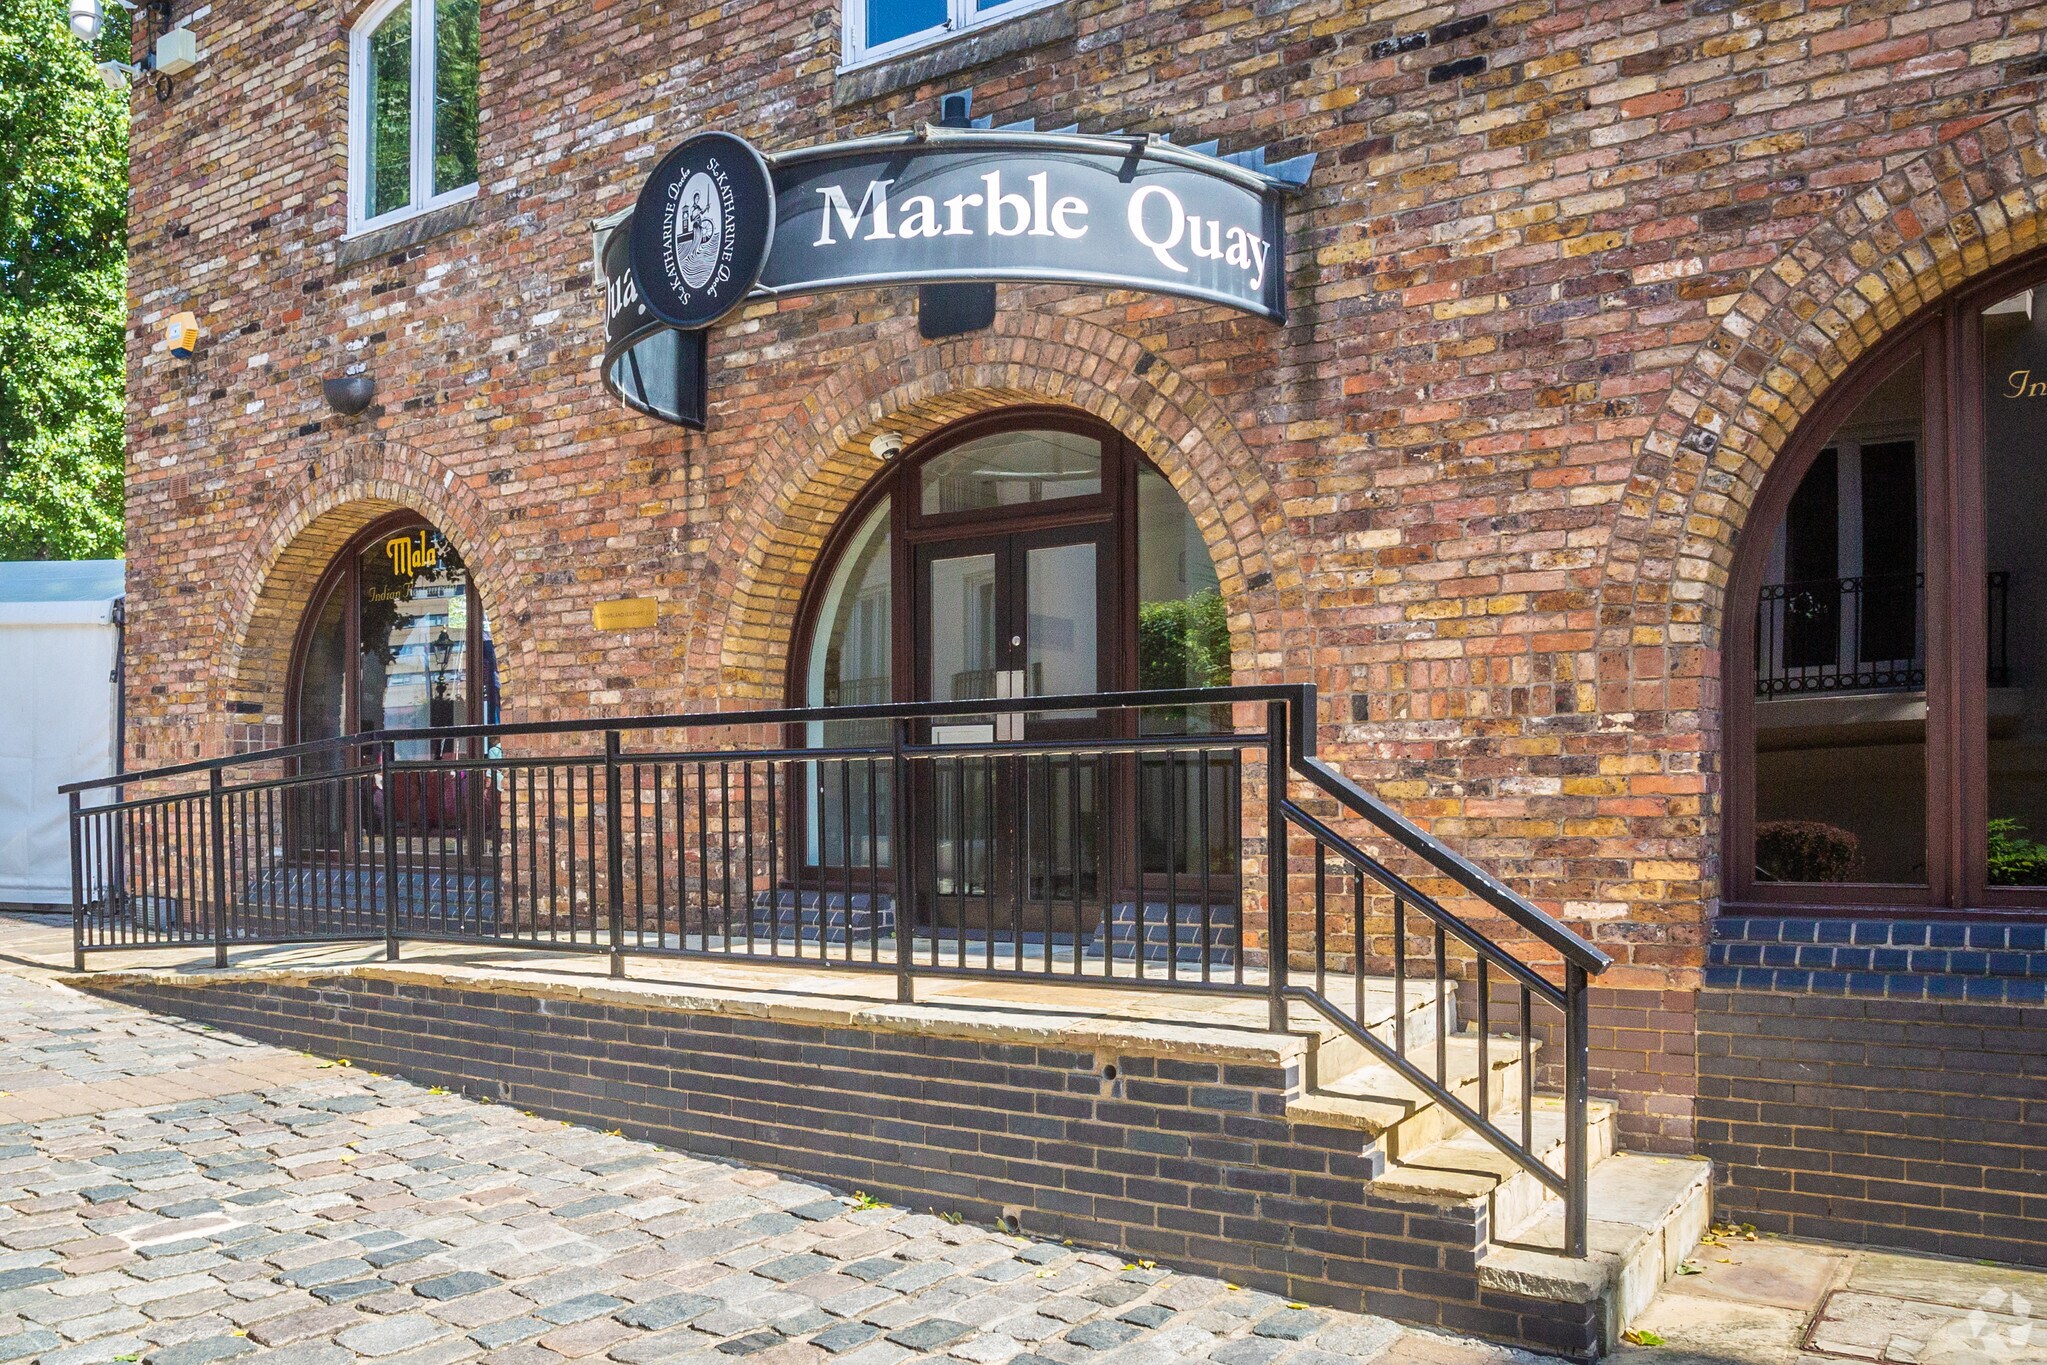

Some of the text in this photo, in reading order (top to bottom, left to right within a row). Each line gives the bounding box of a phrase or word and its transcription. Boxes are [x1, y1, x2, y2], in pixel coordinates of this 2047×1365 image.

[668, 167, 691, 201] Docks
[716, 172, 736, 262] KATHARINE
[812, 169, 1271, 291] Marble Quay
[662, 203, 682, 291] KATHARINE
[706, 264, 731, 298] Docks
[386, 530, 437, 577] Mala
[368, 583, 401, 602] Indian
